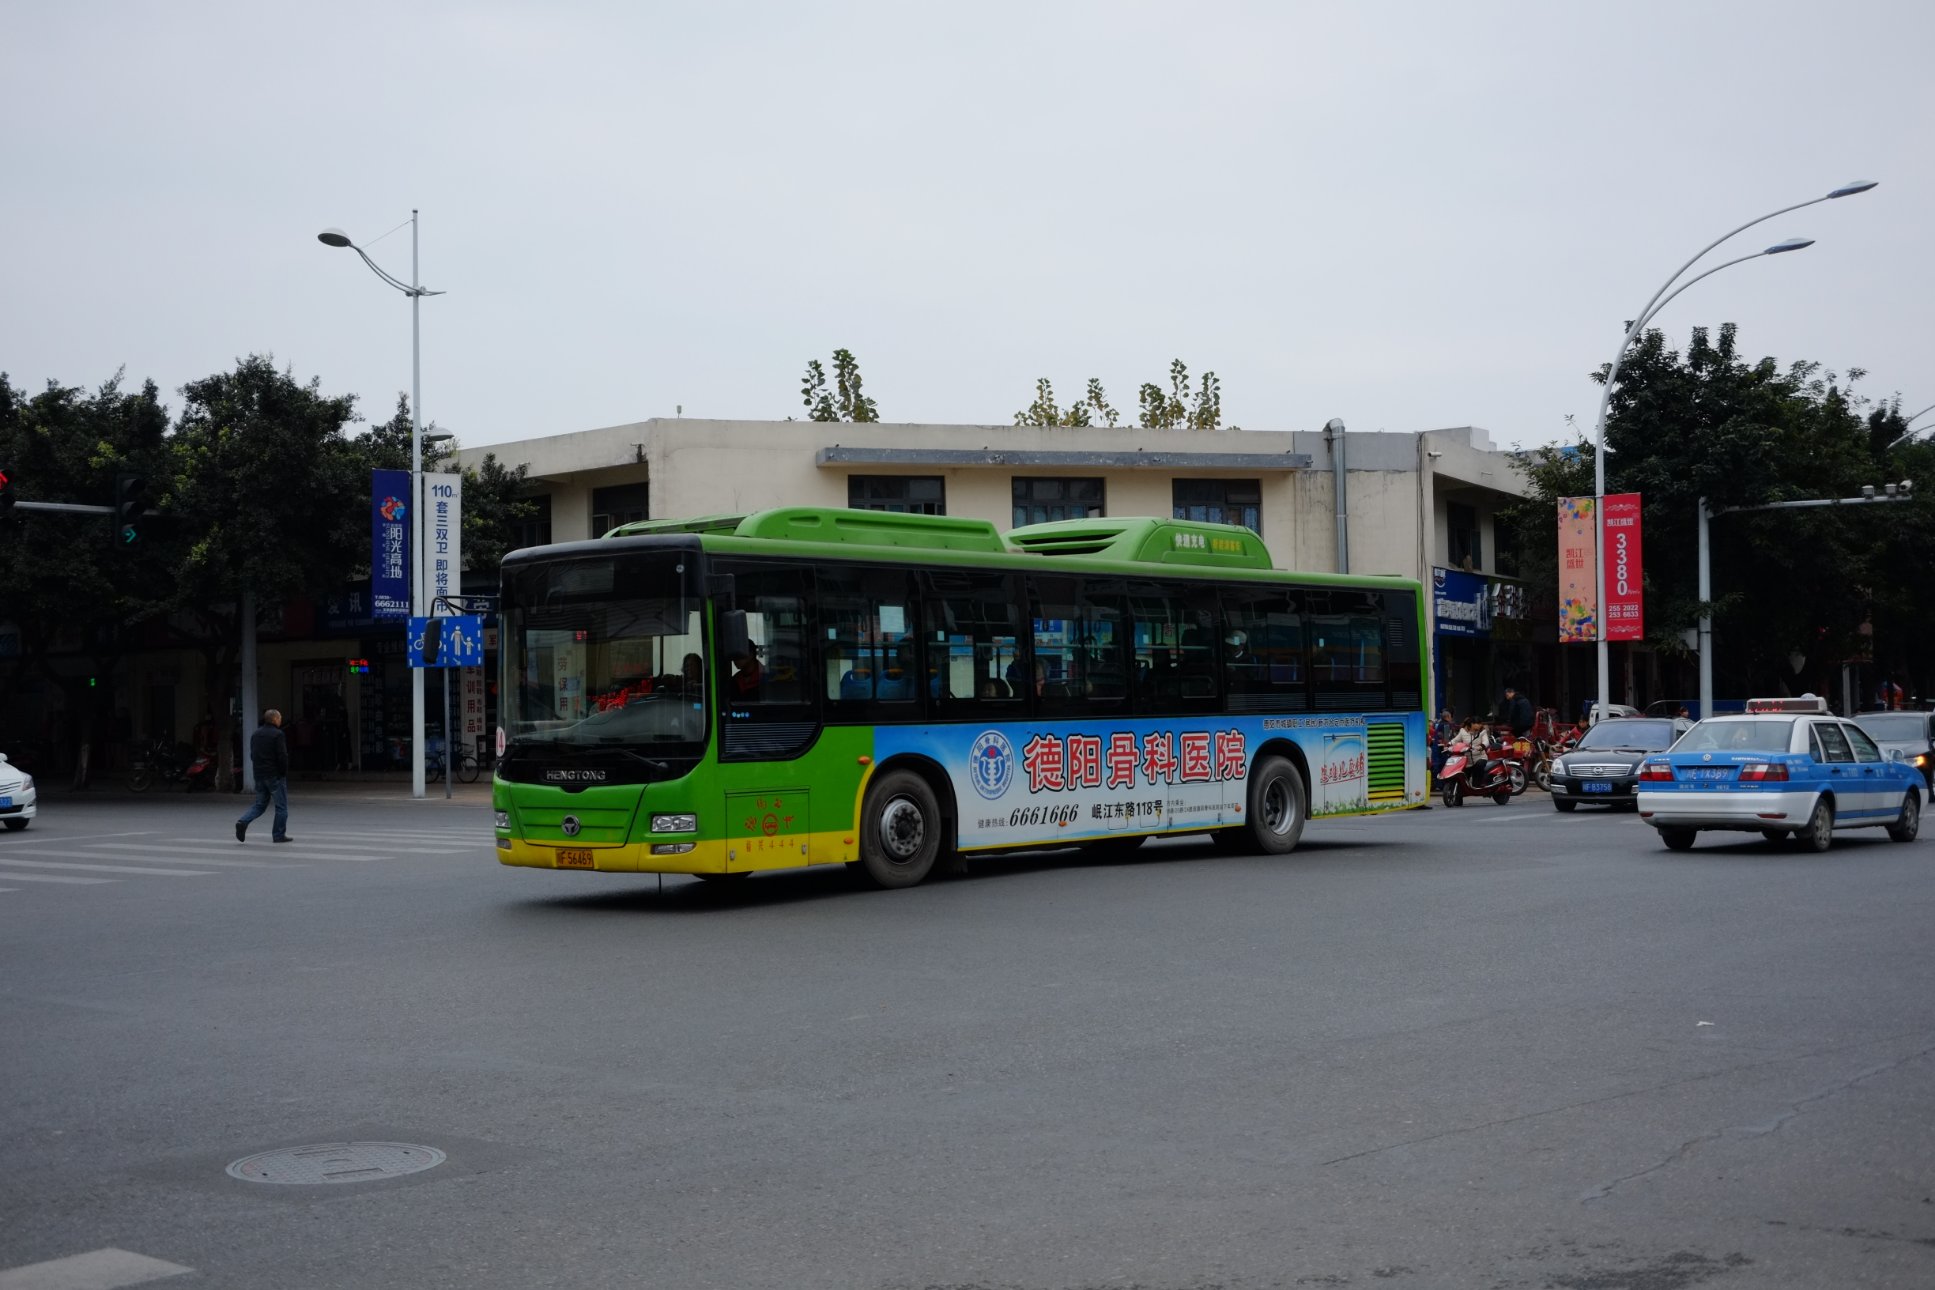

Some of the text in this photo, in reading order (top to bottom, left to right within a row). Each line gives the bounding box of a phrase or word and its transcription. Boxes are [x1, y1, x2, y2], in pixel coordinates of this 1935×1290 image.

[436, 501, 448, 554] 套三双卫
[390, 527, 403, 579] 阳光高地
[1616, 533, 1628, 596] 3380
[374, 600, 409, 608] 6662111
[546, 770, 606, 780] HENGTONG
[1024, 729, 1246, 793] 德阳骨科医院
[1009, 804, 1079, 827] 6661666
[1091, 799, 1164, 819] 岷江东路118号
